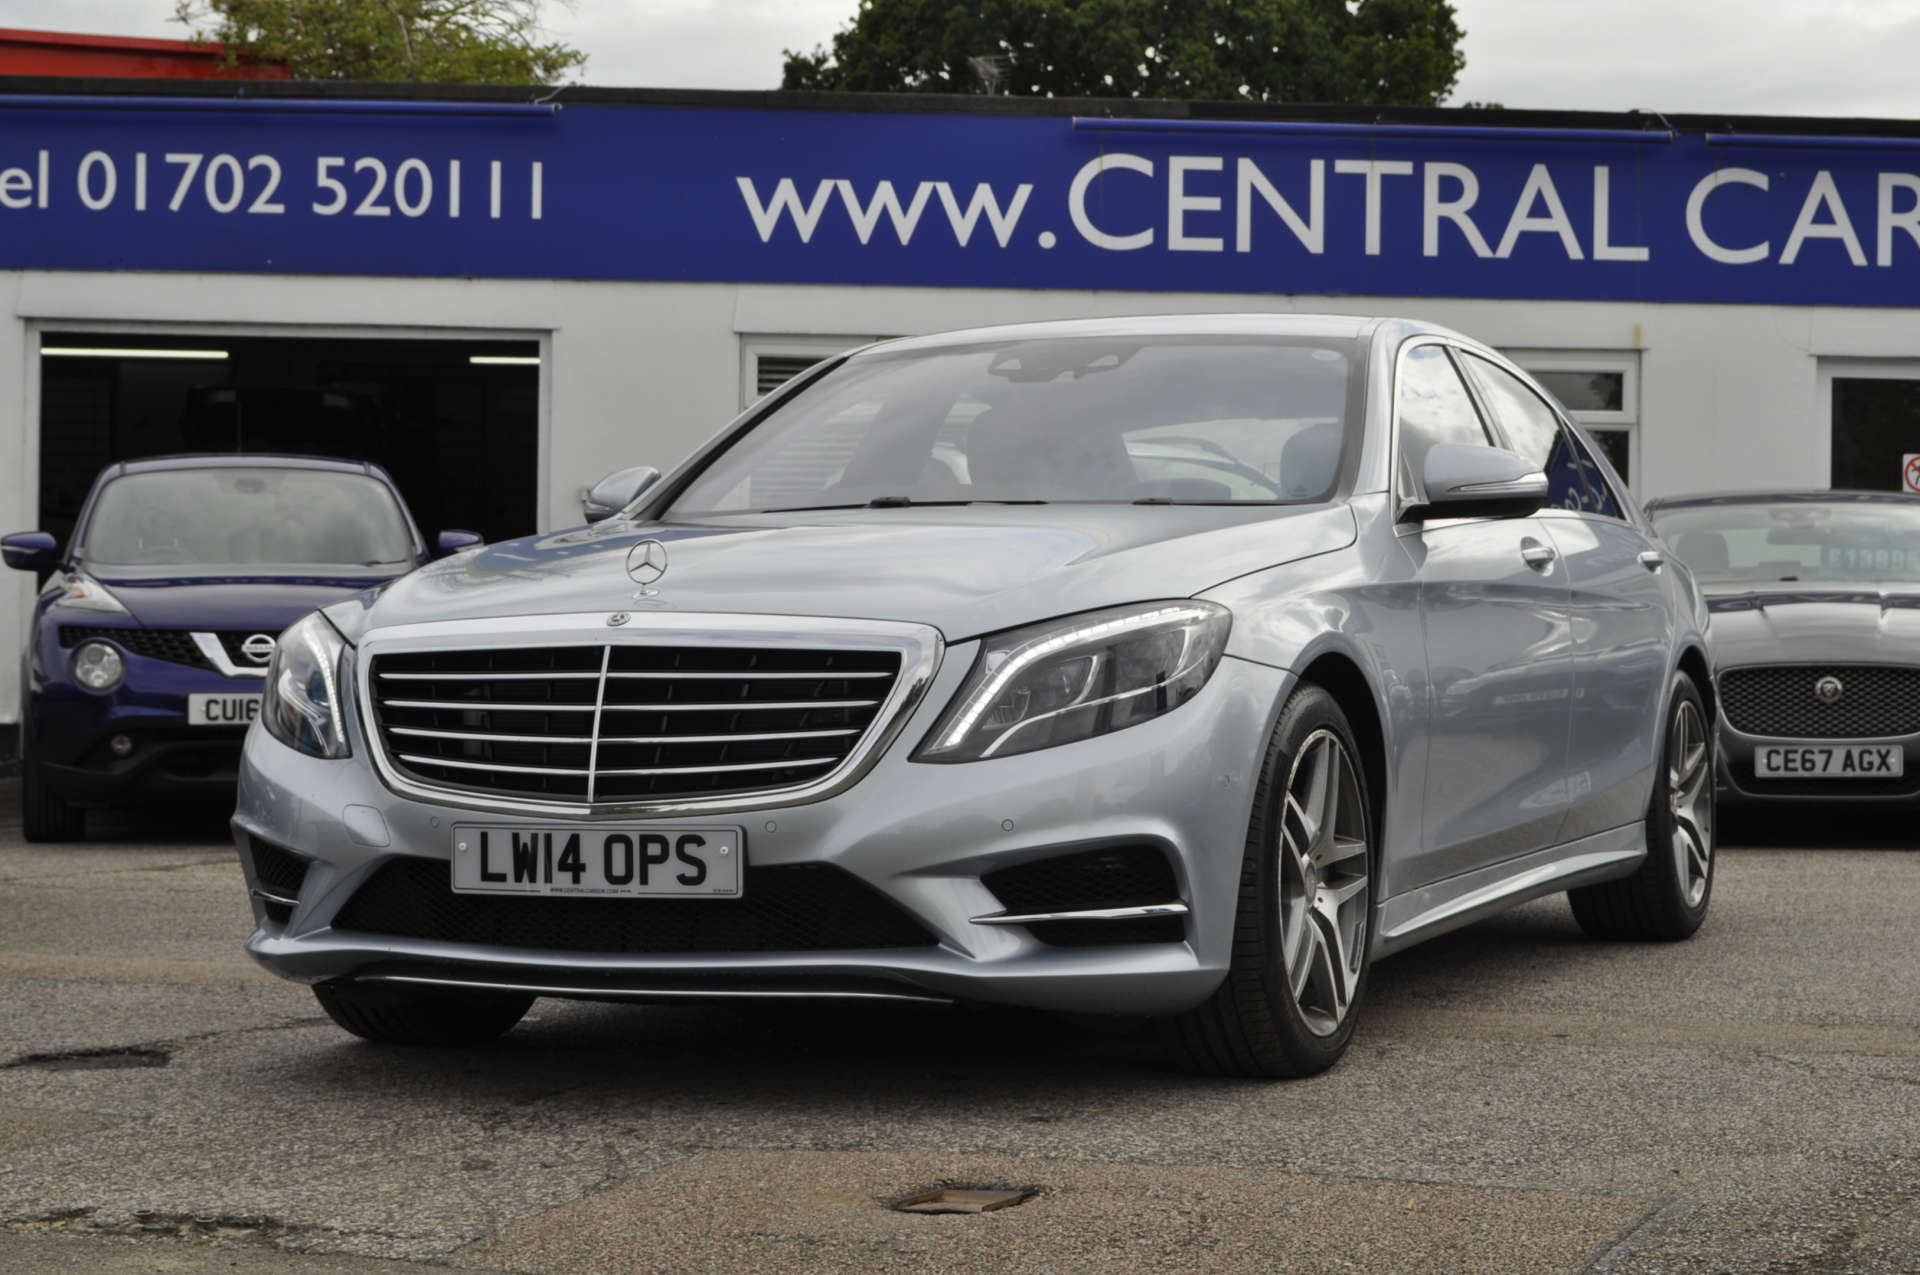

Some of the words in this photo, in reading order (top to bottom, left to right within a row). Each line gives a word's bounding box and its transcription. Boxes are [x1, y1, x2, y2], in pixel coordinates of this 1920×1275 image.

[0, 150, 49, 209] el
[77, 152, 285, 214] 01702
[312, 156, 543, 220] 520111
[736, 153, 1650, 261] www.CENTRAL
[1685, 168, 1920, 267] CAR
[205, 699, 260, 721] CU16
[1766, 748, 1833, 772] CE67
[1841, 748, 1892, 772] AGX
[479, 831, 587, 885] LW14
[603, 833, 707, 887] OPS
